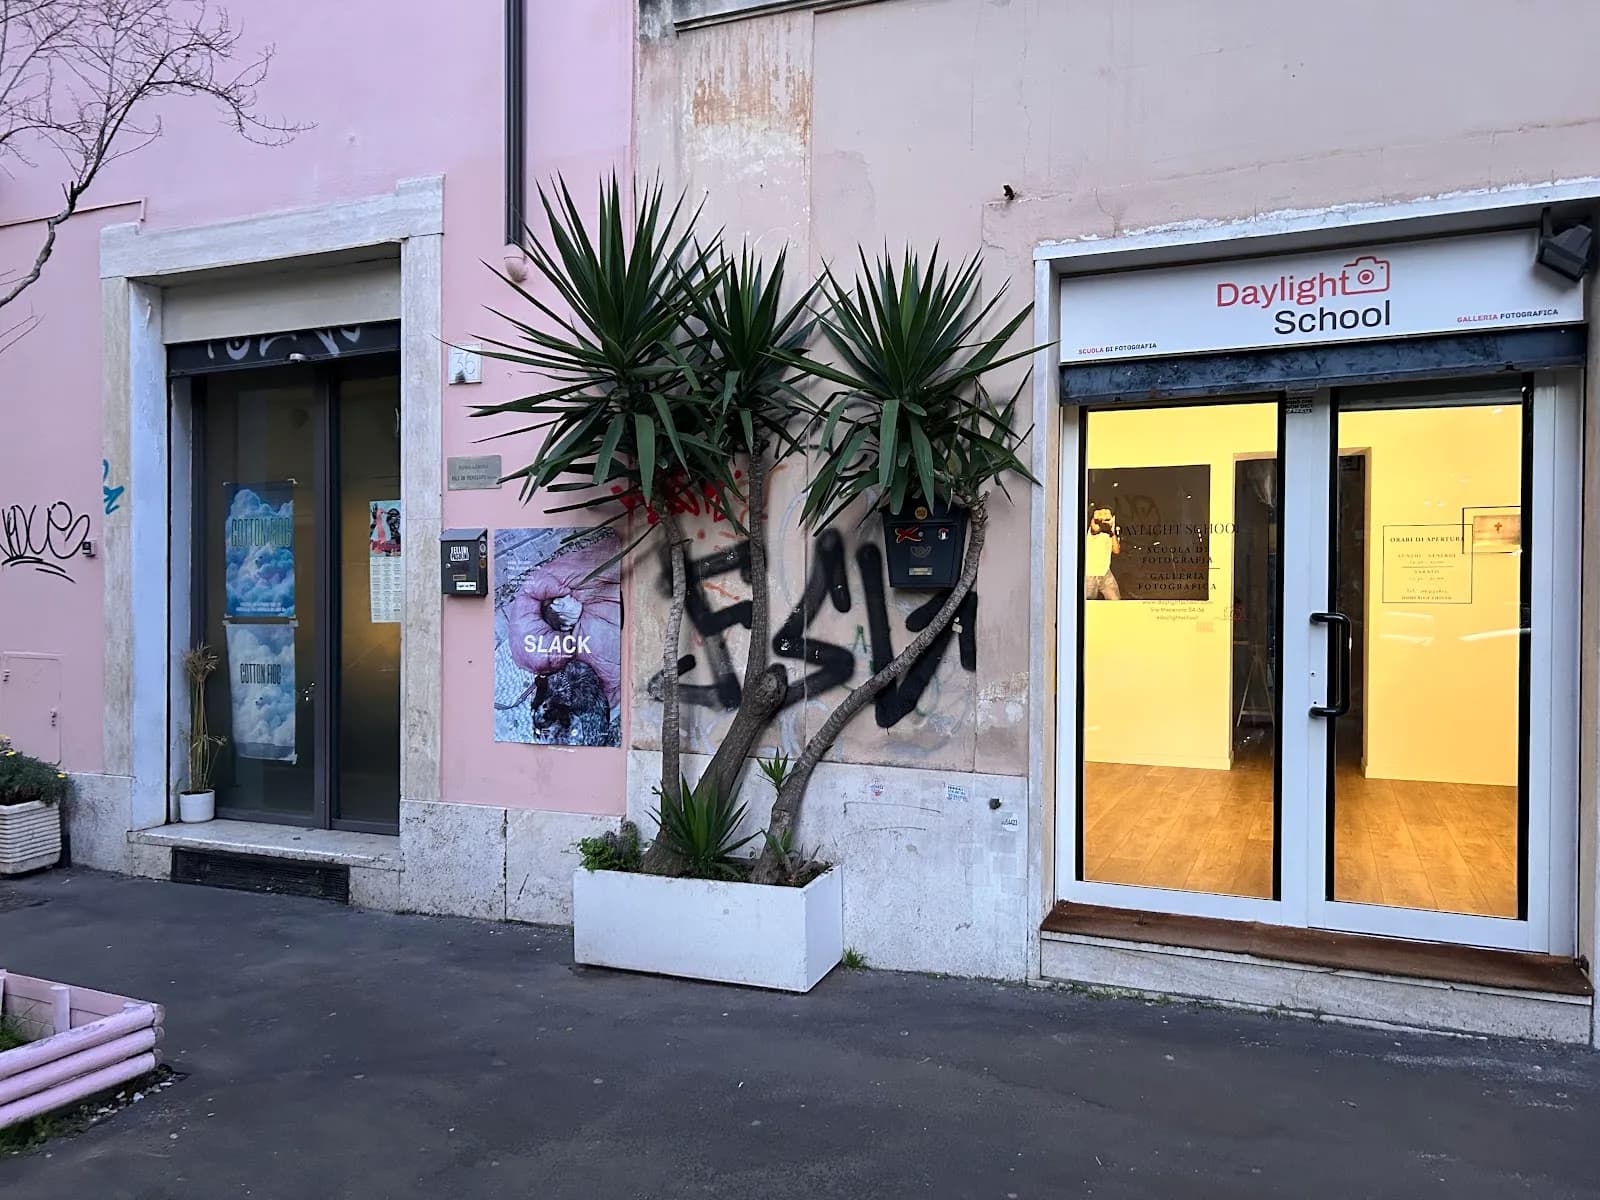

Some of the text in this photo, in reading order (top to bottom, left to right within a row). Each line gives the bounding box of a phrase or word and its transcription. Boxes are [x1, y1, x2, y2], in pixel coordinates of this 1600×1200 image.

[1217, 270, 1349, 309] Daylight
[1274, 300, 1390, 335] School
[1457, 309, 1559, 323] GALLERIA FOTOGRAFICA
[1078, 347, 1104, 355] SCUOLA
[1114, 342, 1157, 352] FOTOGRAFIA
[231, 517, 266, 546] COTTON
[523, 634, 592, 654] SLACK
[240, 663, 265, 684] COTTON
